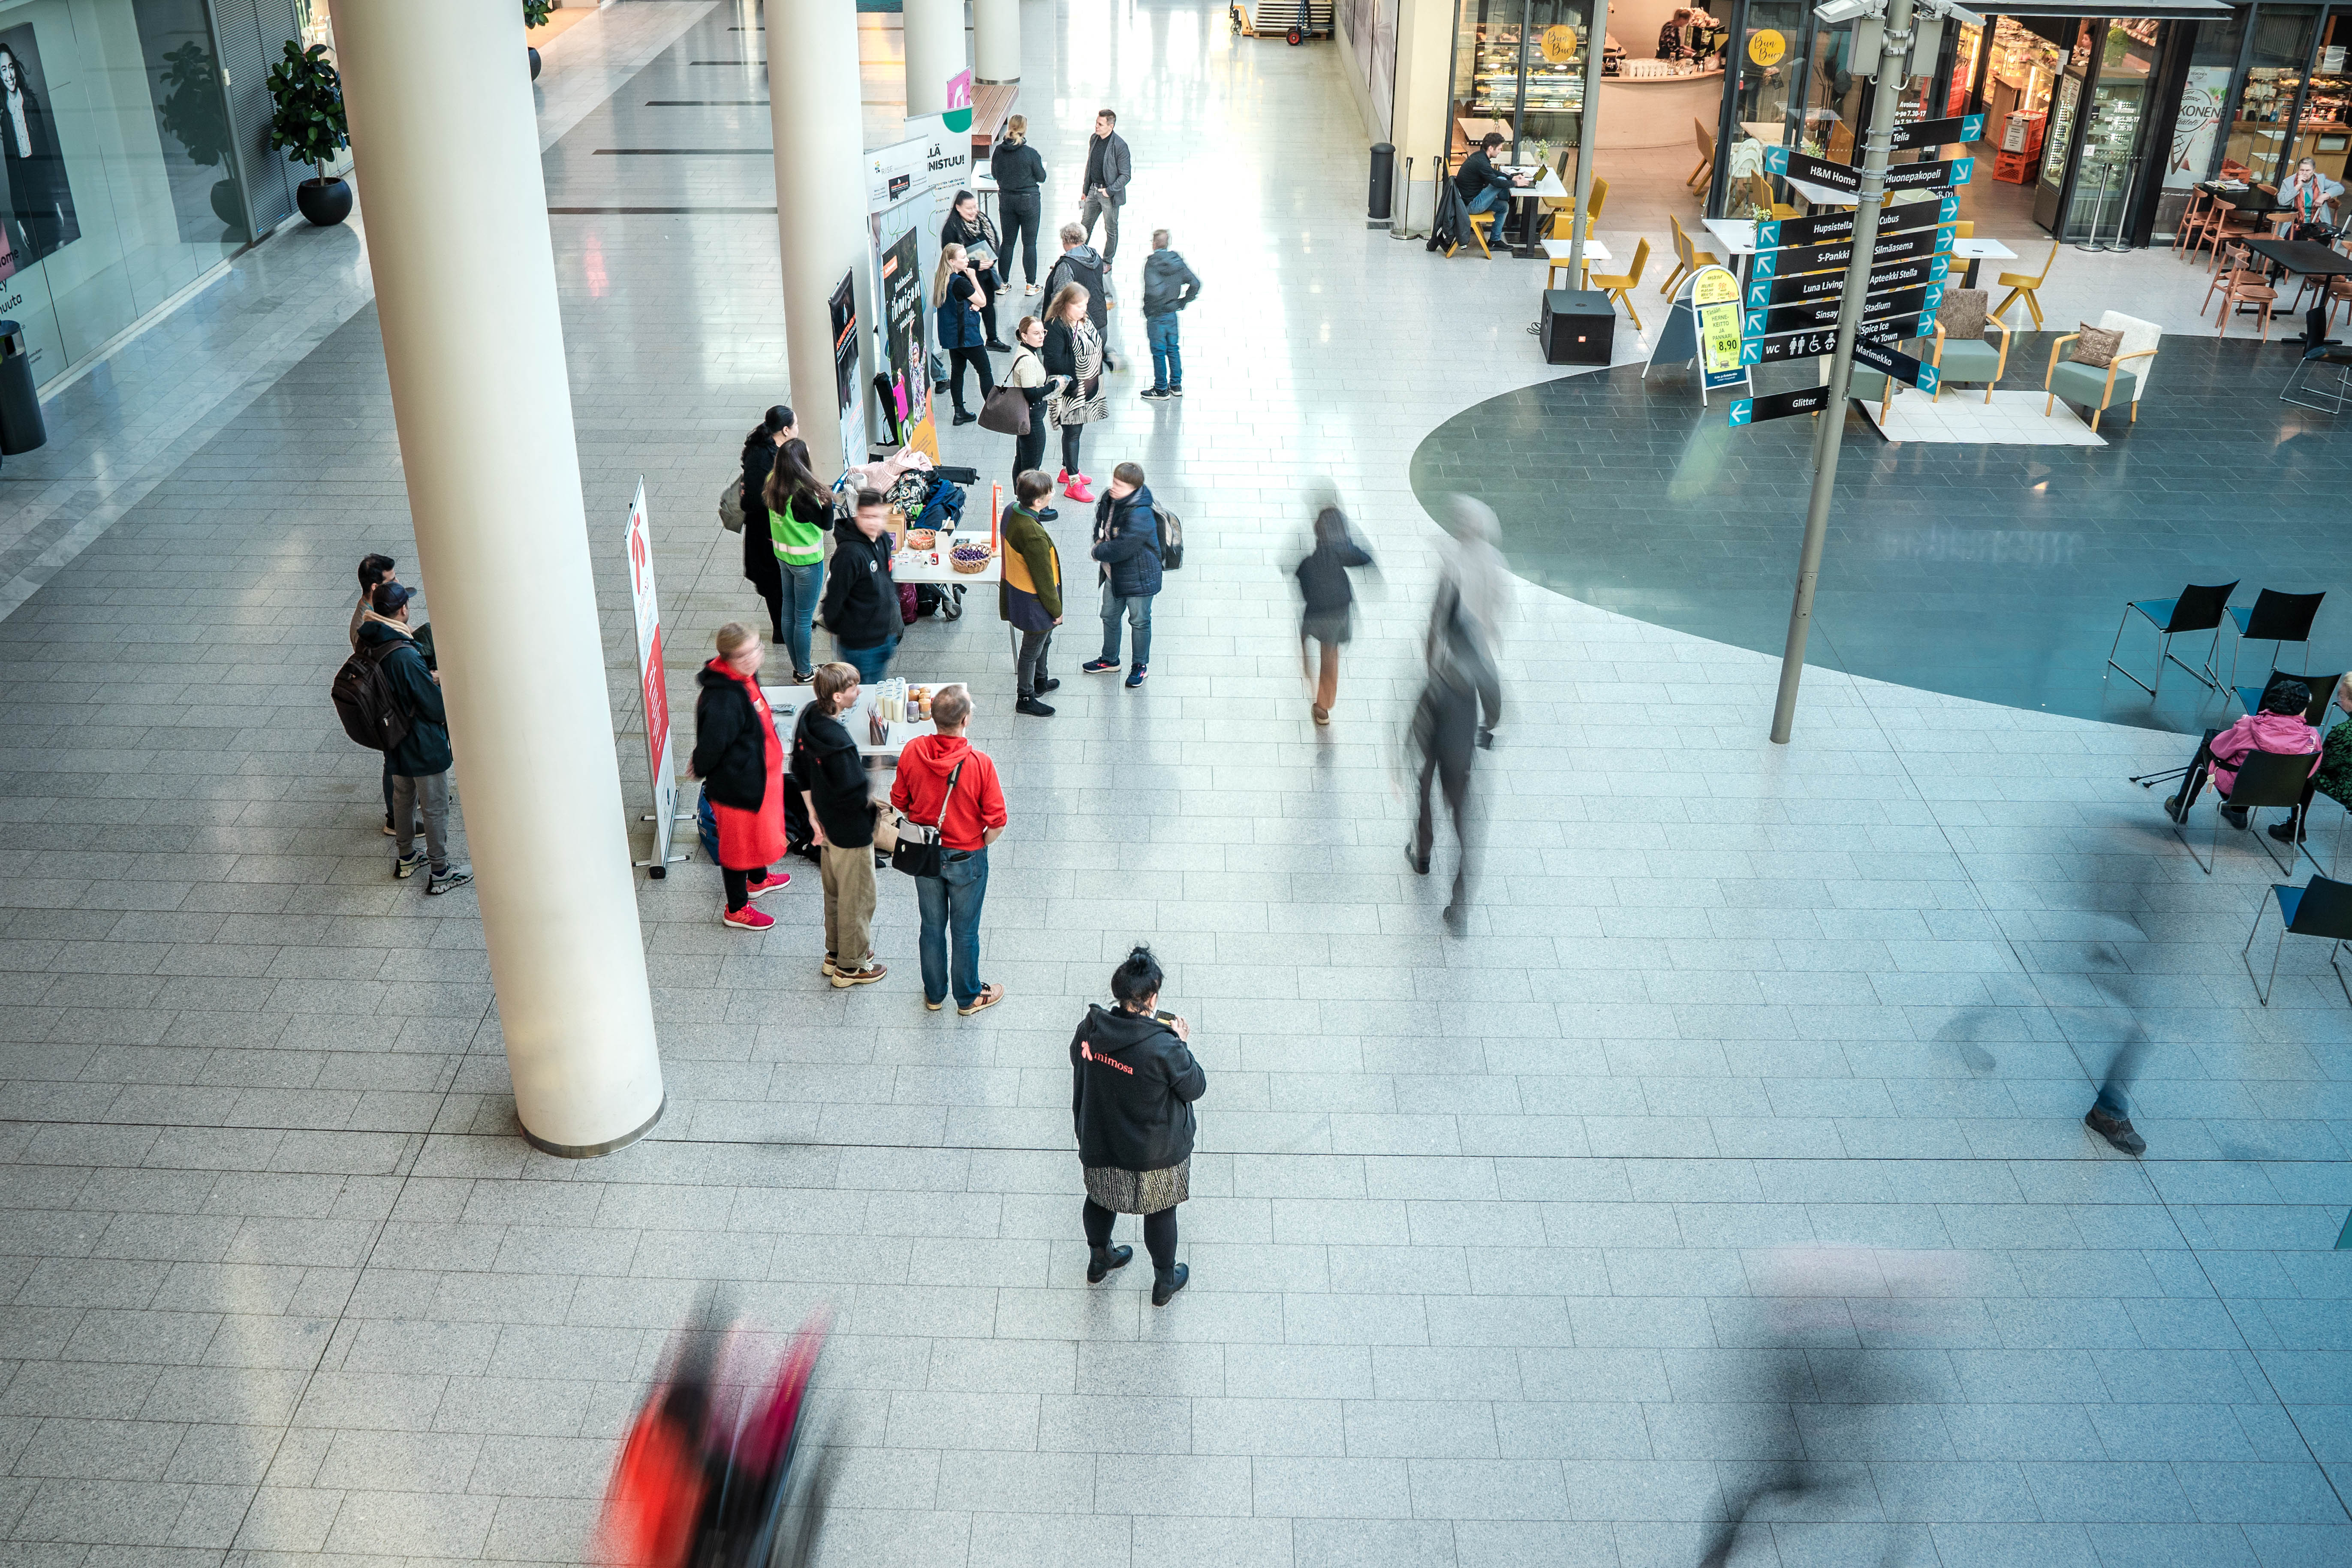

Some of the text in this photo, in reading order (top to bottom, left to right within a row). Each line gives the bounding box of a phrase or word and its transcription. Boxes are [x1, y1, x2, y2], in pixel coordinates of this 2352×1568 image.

[1548, 31, 1568, 45] Bun
[1754, 36, 1776, 49] Bun
[2178, 105, 2221, 118] KONEN
[1894, 132, 1910, 142] Telia
[928, 143, 941, 158] LÄ
[928, 154, 964, 172] NISTUU!
[881, 166, 893, 175] RISE
[1810, 166, 1856, 186] H&M Home
[1886, 169, 1941, 183] Huonepakopeli
[1879, 214, 1899, 225] Cubus
[1814, 221, 1852, 234] Hupsistella
[1874, 242, 1913, 255] Silmäasema
[1817, 250, 1850, 262] S-Pankki
[894, 267, 913, 293] Rohkeasti
[1869, 268, 1918, 285] Apteekki Stella
[1803, 280, 1843, 294] Luna Living
[891, 280, 920, 322] ihmisen
[1864, 301, 1891, 313] Stadium
[1707, 307, 1721, 316] Tänään
[1815, 310, 1839, 319] Sinsay
[1861, 322, 1889, 336] Spice Ice
[1881, 333, 1898, 342] Town
[1719, 340, 1737, 352] 8,90
[1766, 344, 1780, 354] WC
[1856, 343, 1892, 366] Marimekko
[1792, 398, 1817, 407] Glitter
[1094, 1053, 1133, 1075] mimosa
